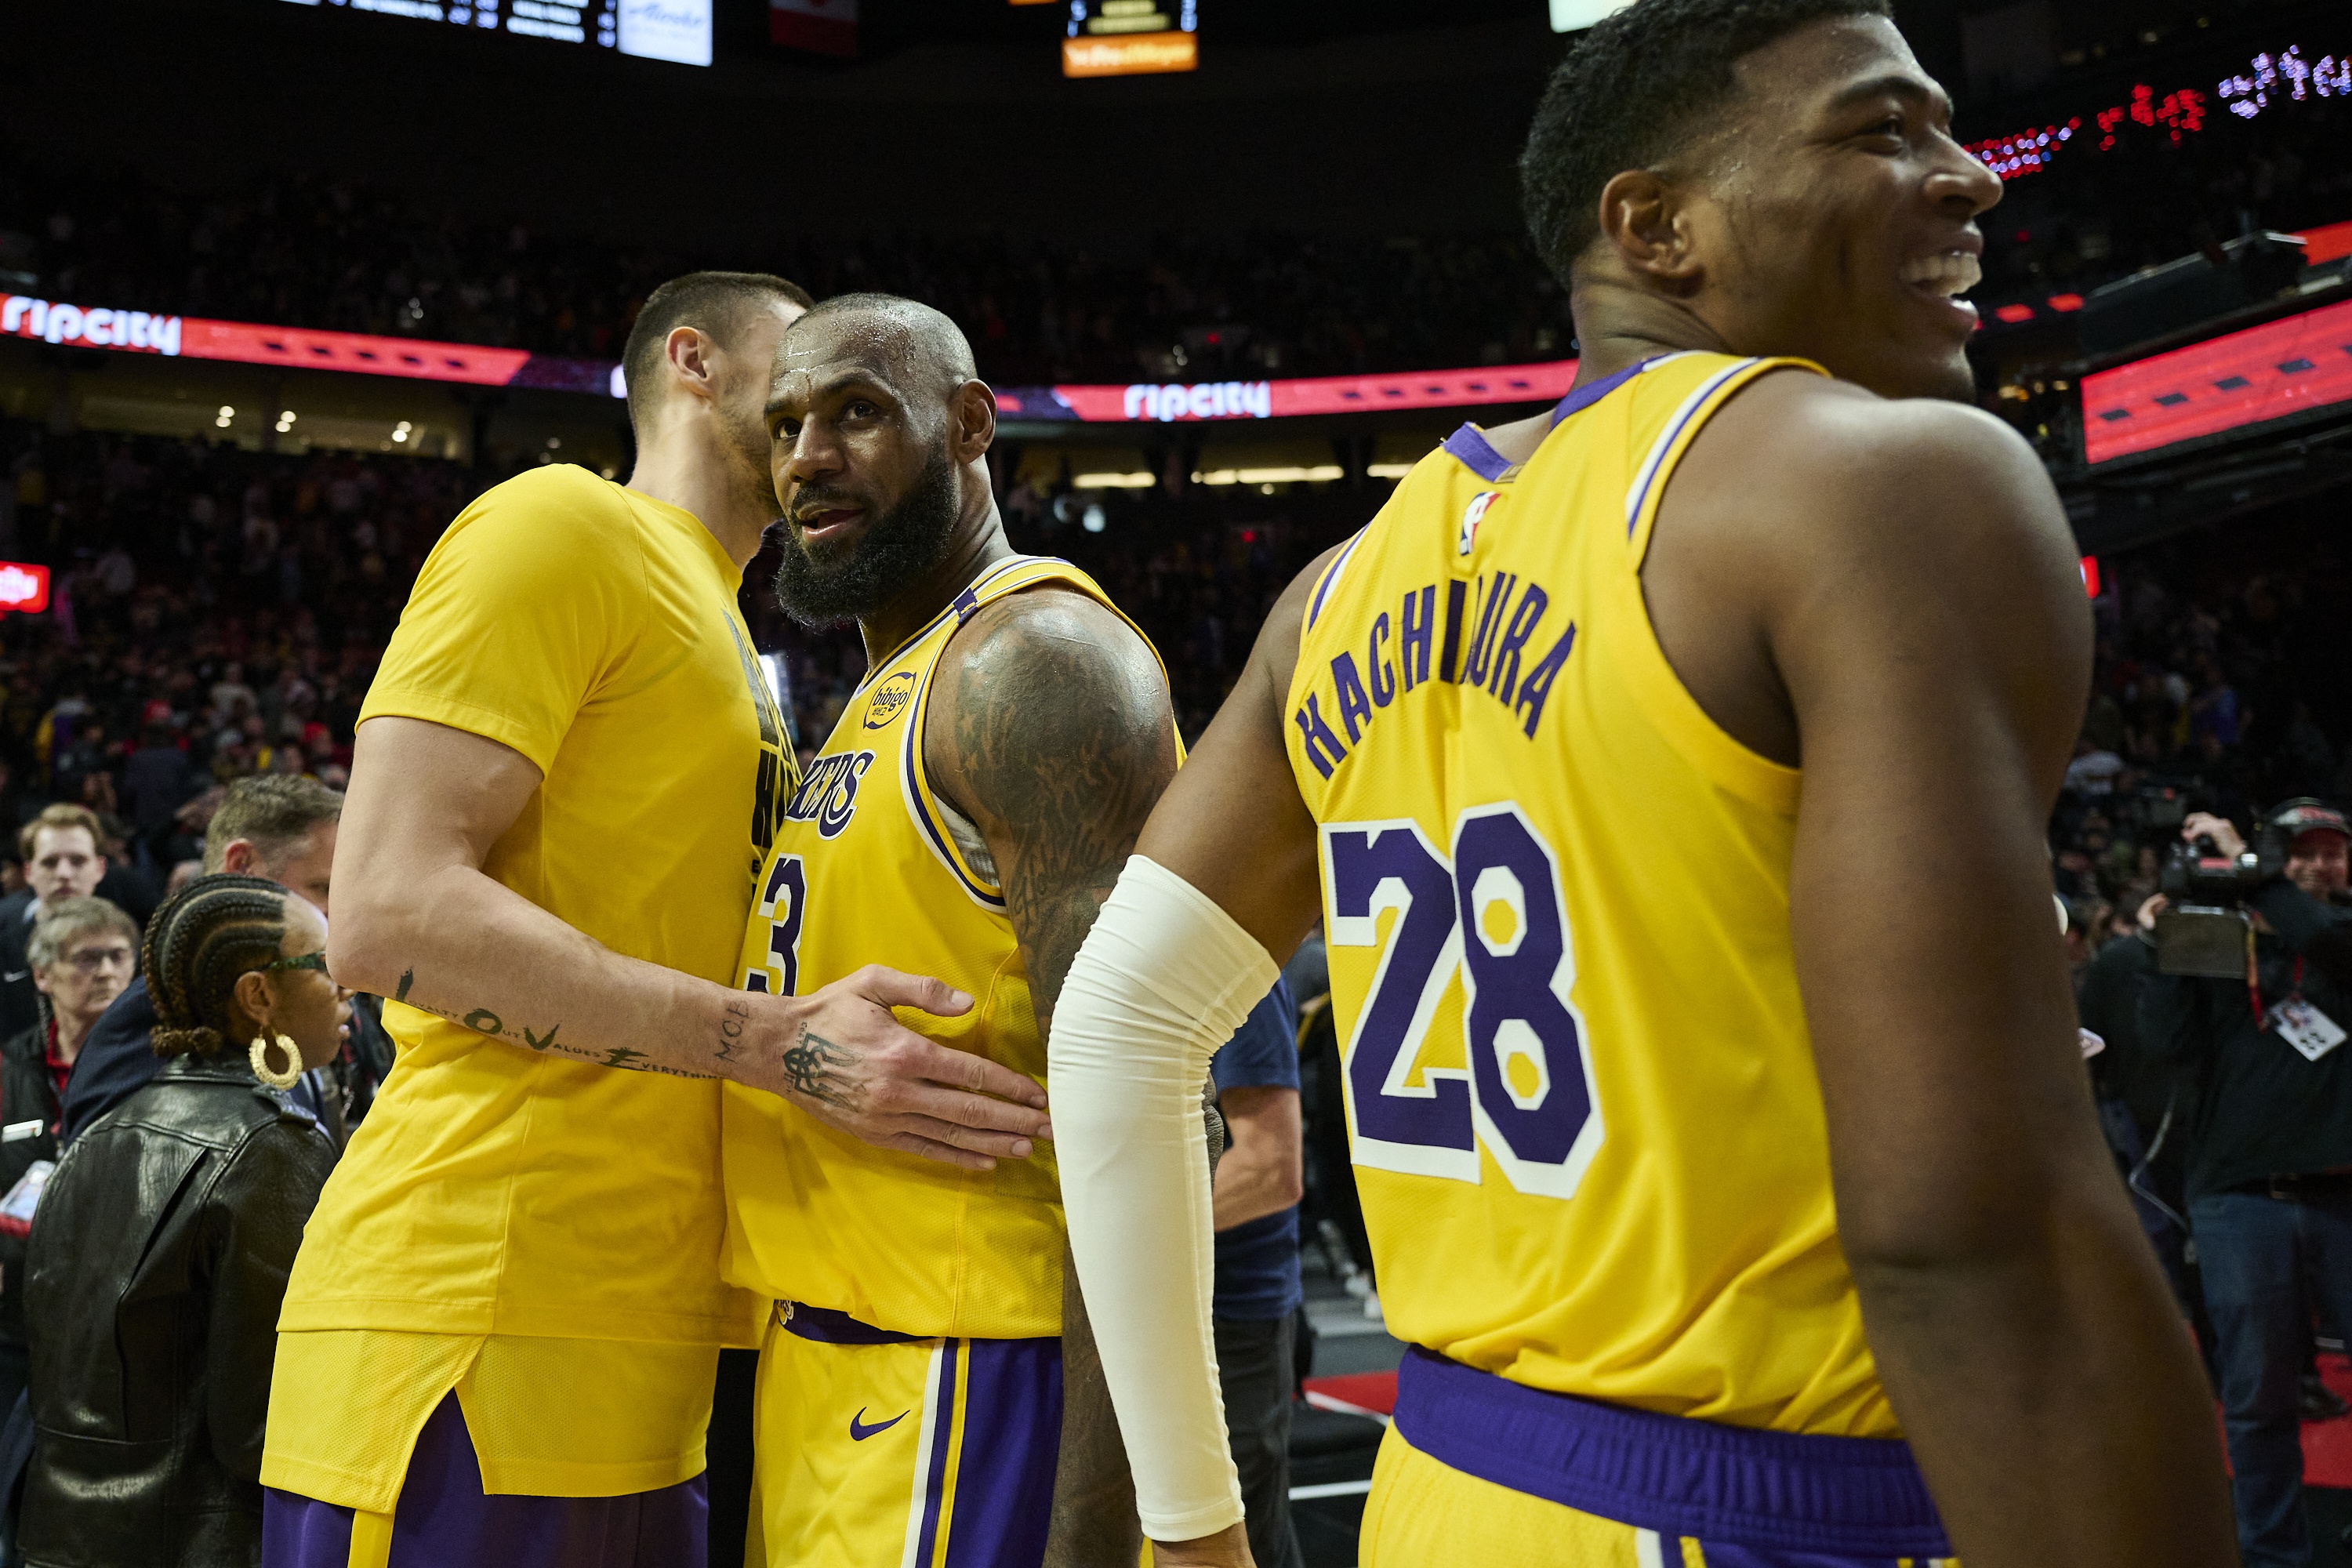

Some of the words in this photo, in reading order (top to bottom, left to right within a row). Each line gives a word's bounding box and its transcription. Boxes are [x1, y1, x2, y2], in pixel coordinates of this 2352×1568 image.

[3, 296, 181, 355] ripcity
[1124, 380, 1271, 422] ripcity
[873, 686, 909, 712] bibigo
[1295, 571, 1577, 781] HACHIURA
[742, 852, 808, 996] 3
[1319, 800, 1606, 1200] 28
